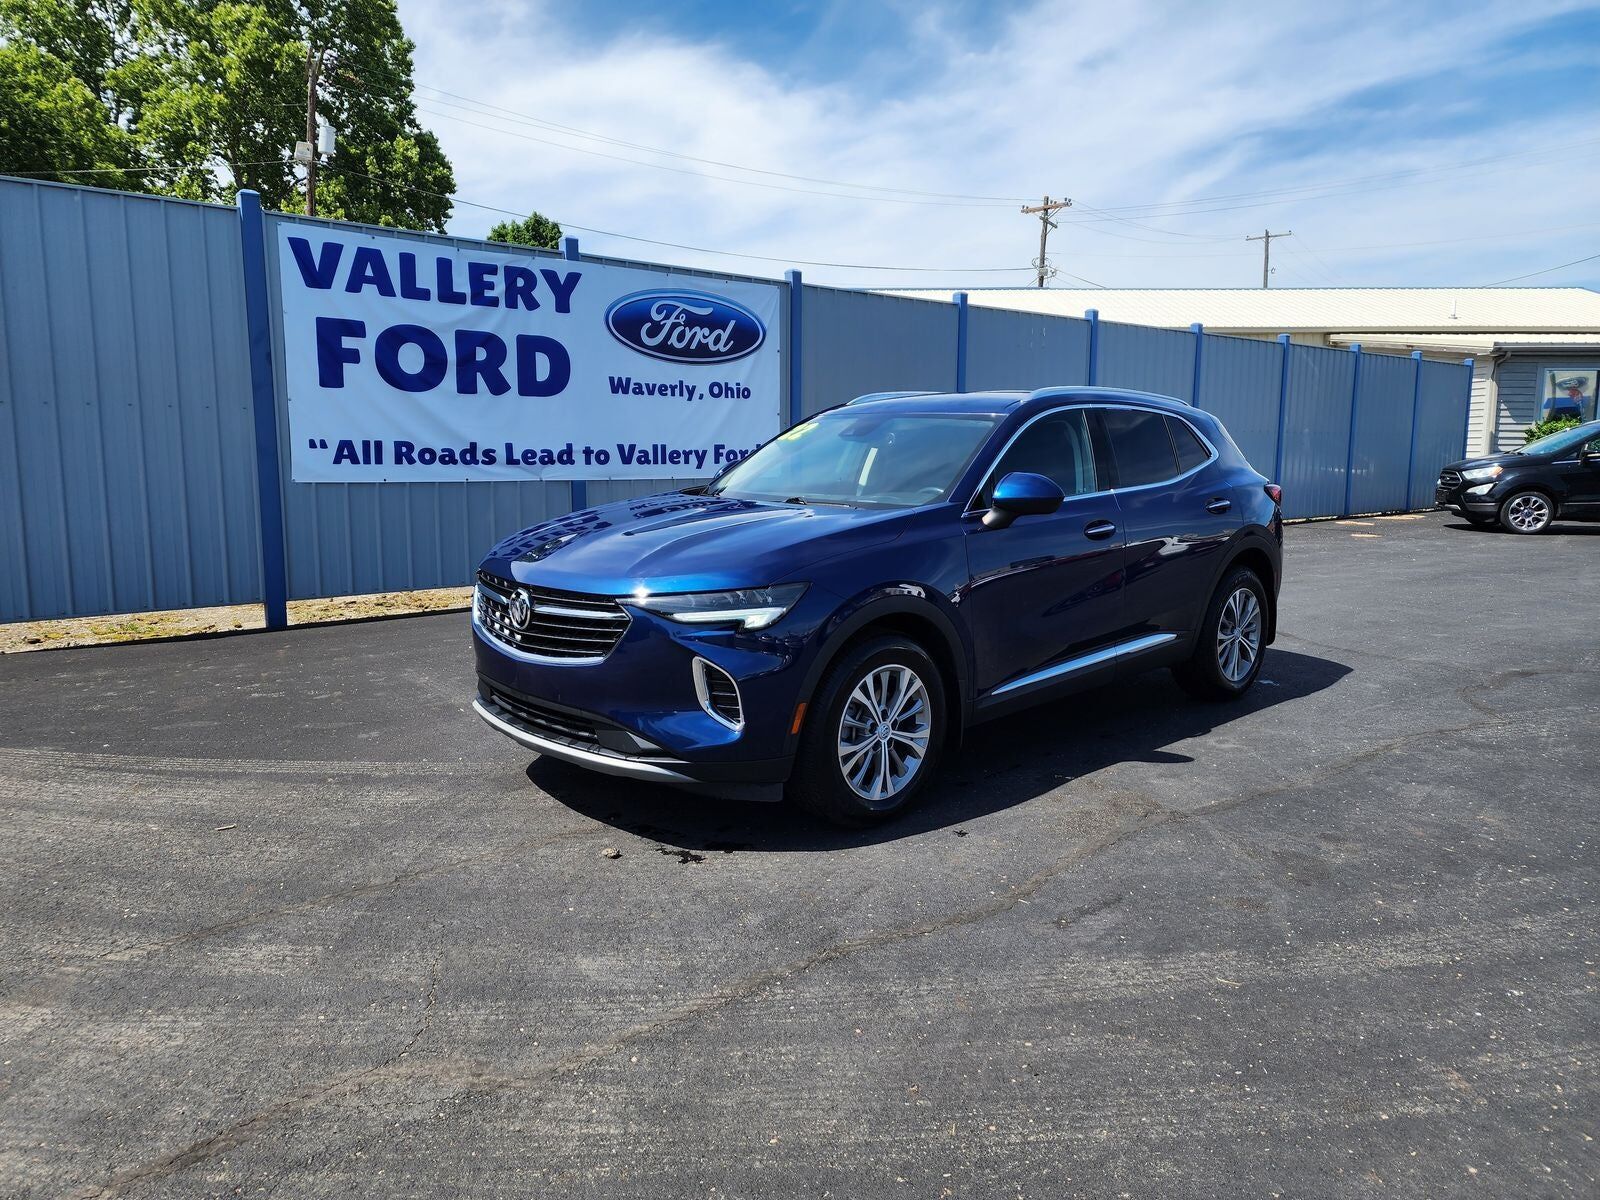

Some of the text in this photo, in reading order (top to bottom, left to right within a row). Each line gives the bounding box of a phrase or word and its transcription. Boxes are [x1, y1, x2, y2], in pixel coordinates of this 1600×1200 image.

[288, 237, 582, 313] VALLERY
[640, 300, 736, 352] Ford
[316, 317, 571, 397] FORD
[608, 376, 751, 401] Waverly, Ohio
[393, 440, 497, 466] Roads
[504, 442, 575, 466] Lead
[582, 446, 611, 466] to
[617, 443, 708, 470] Vallery
